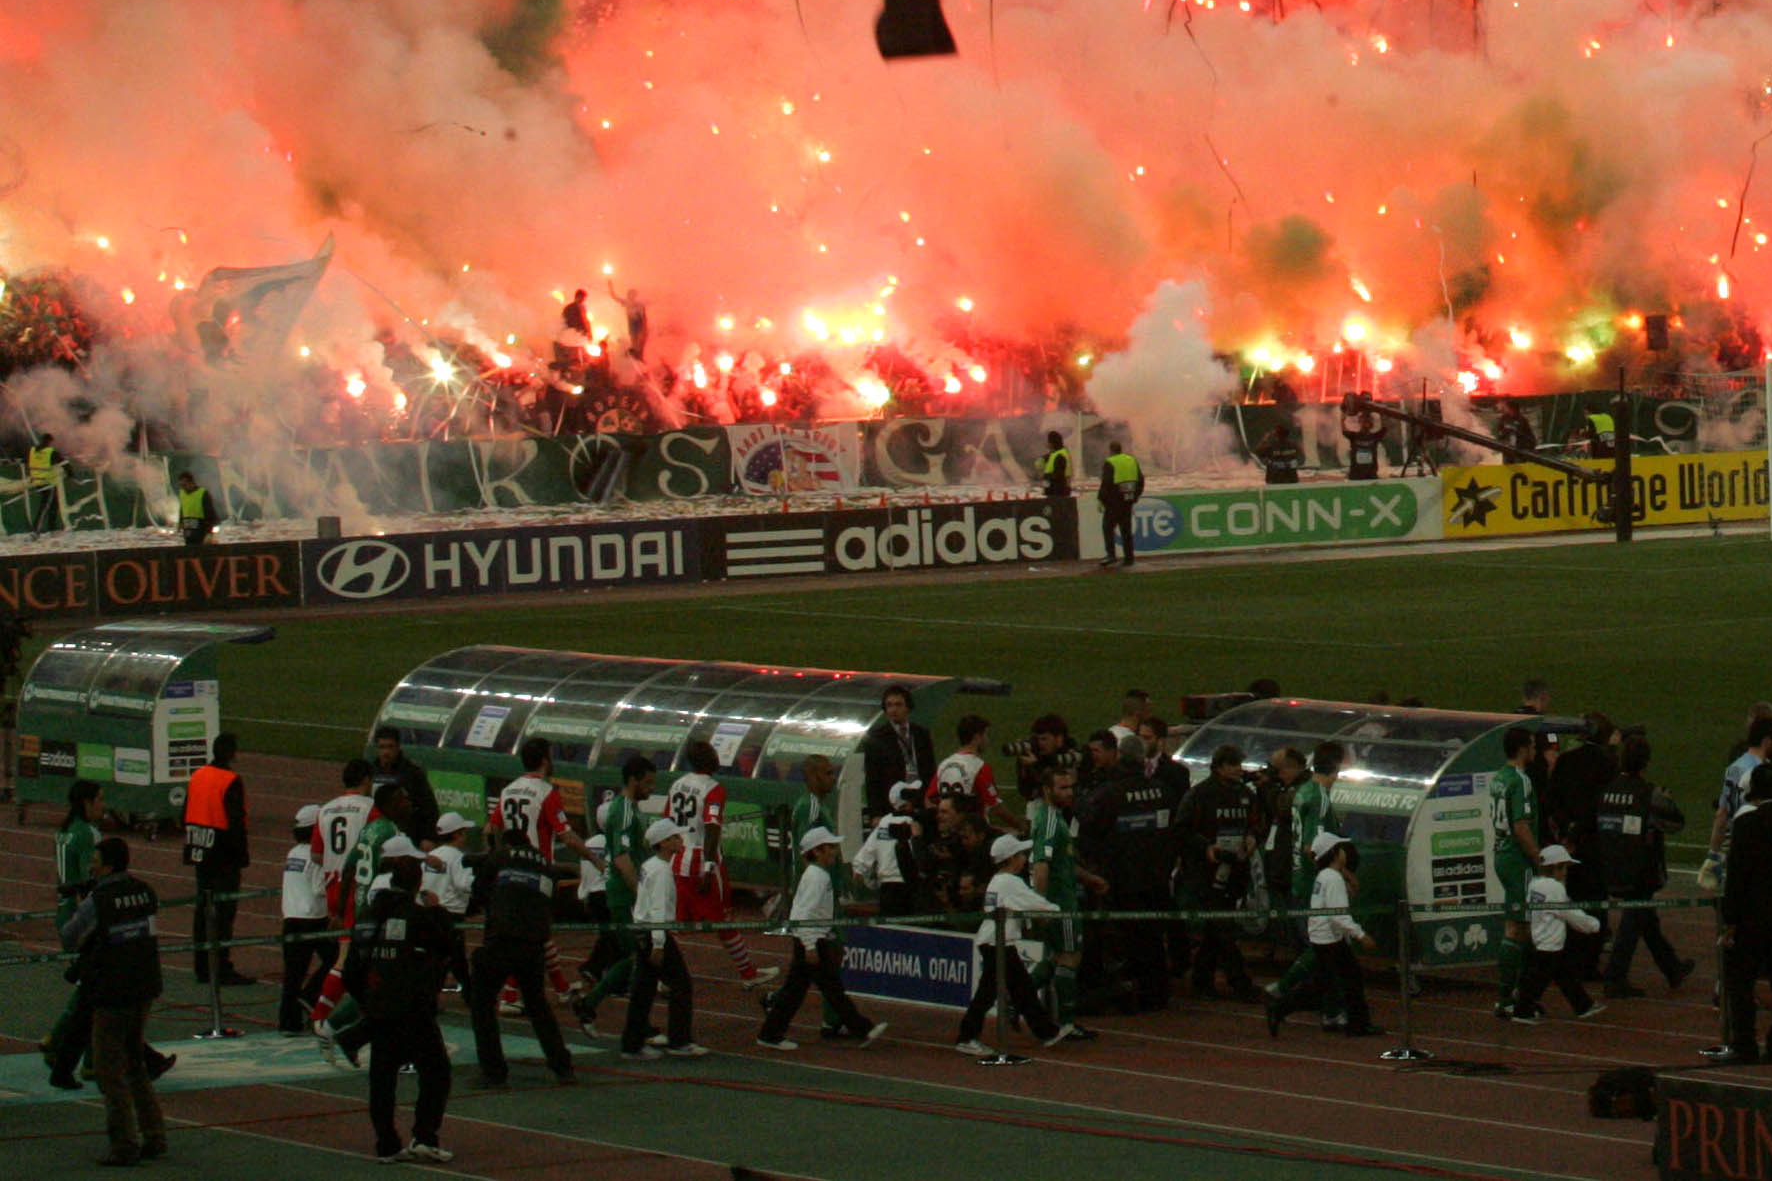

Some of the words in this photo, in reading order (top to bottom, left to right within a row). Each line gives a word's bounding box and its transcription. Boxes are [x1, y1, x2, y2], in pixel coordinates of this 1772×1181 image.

[1678, 459, 1771, 511] World
[836, 506, 1054, 571] adidas
[1190, 493, 1402, 538] CONN-X
[105, 553, 291, 603] OLIVER
[425, 529, 685, 589] HYUNDAI
[1603, 791, 1635, 806] PRESS
[330, 815, 348, 855] 6
